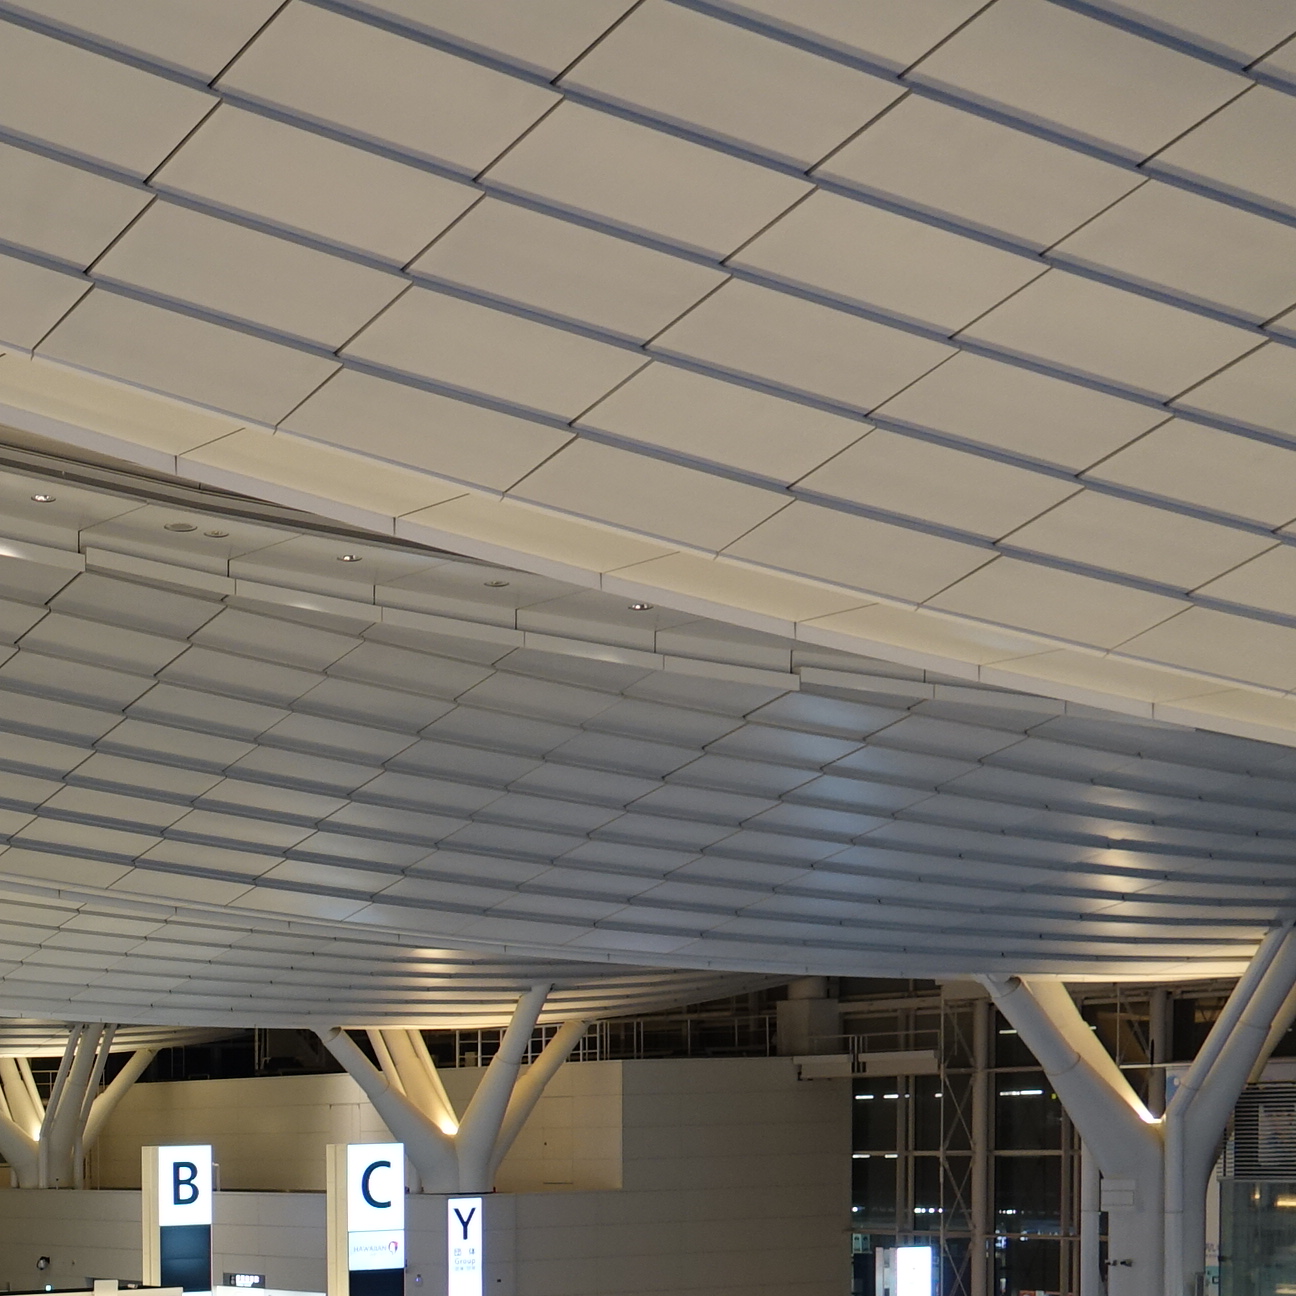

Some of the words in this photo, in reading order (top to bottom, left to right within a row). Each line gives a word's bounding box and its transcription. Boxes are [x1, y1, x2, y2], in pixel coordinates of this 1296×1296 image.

[172, 1161, 199, 1205] B
[361, 1160, 392, 1208] C
[453, 1206, 476, 1241] Y
[454, 1257, 476, 1266] Group
